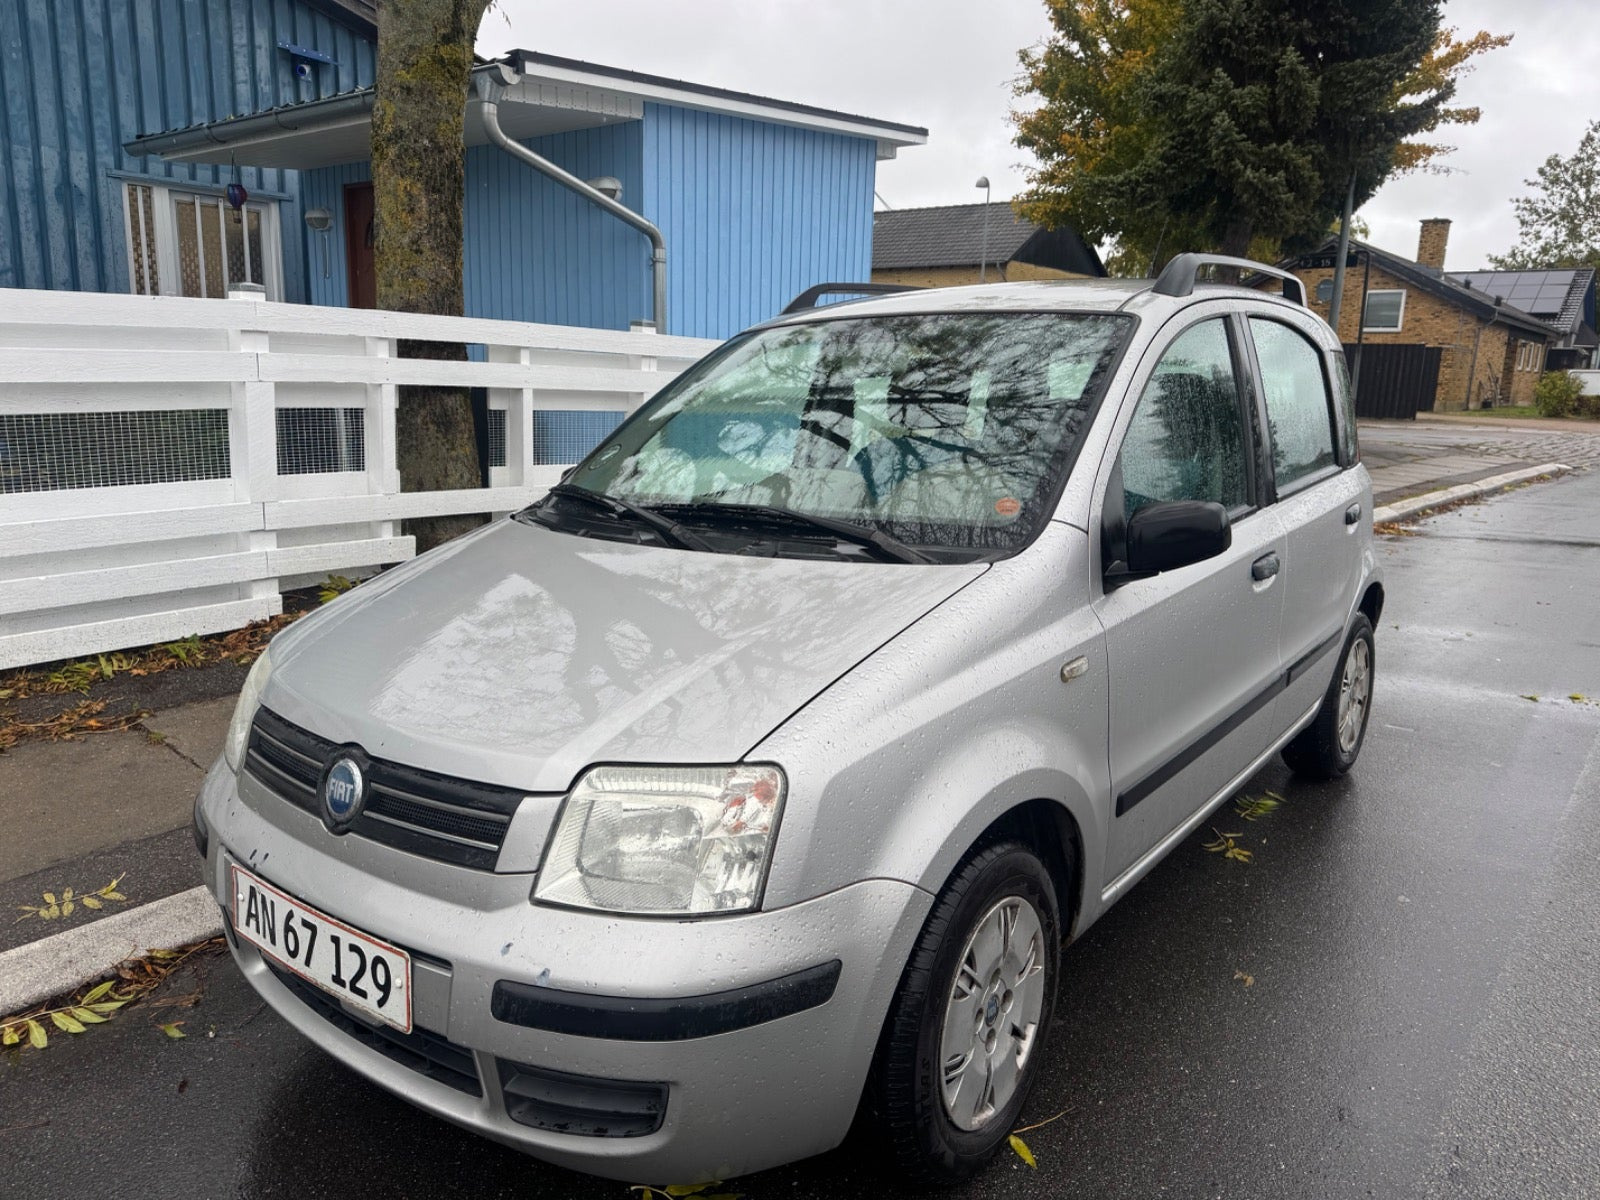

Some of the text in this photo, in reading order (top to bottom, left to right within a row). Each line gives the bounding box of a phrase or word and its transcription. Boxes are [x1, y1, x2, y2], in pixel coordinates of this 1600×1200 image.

[329, 778, 354, 804] FIAT
[245, 885, 392, 1008] AN 67 129
